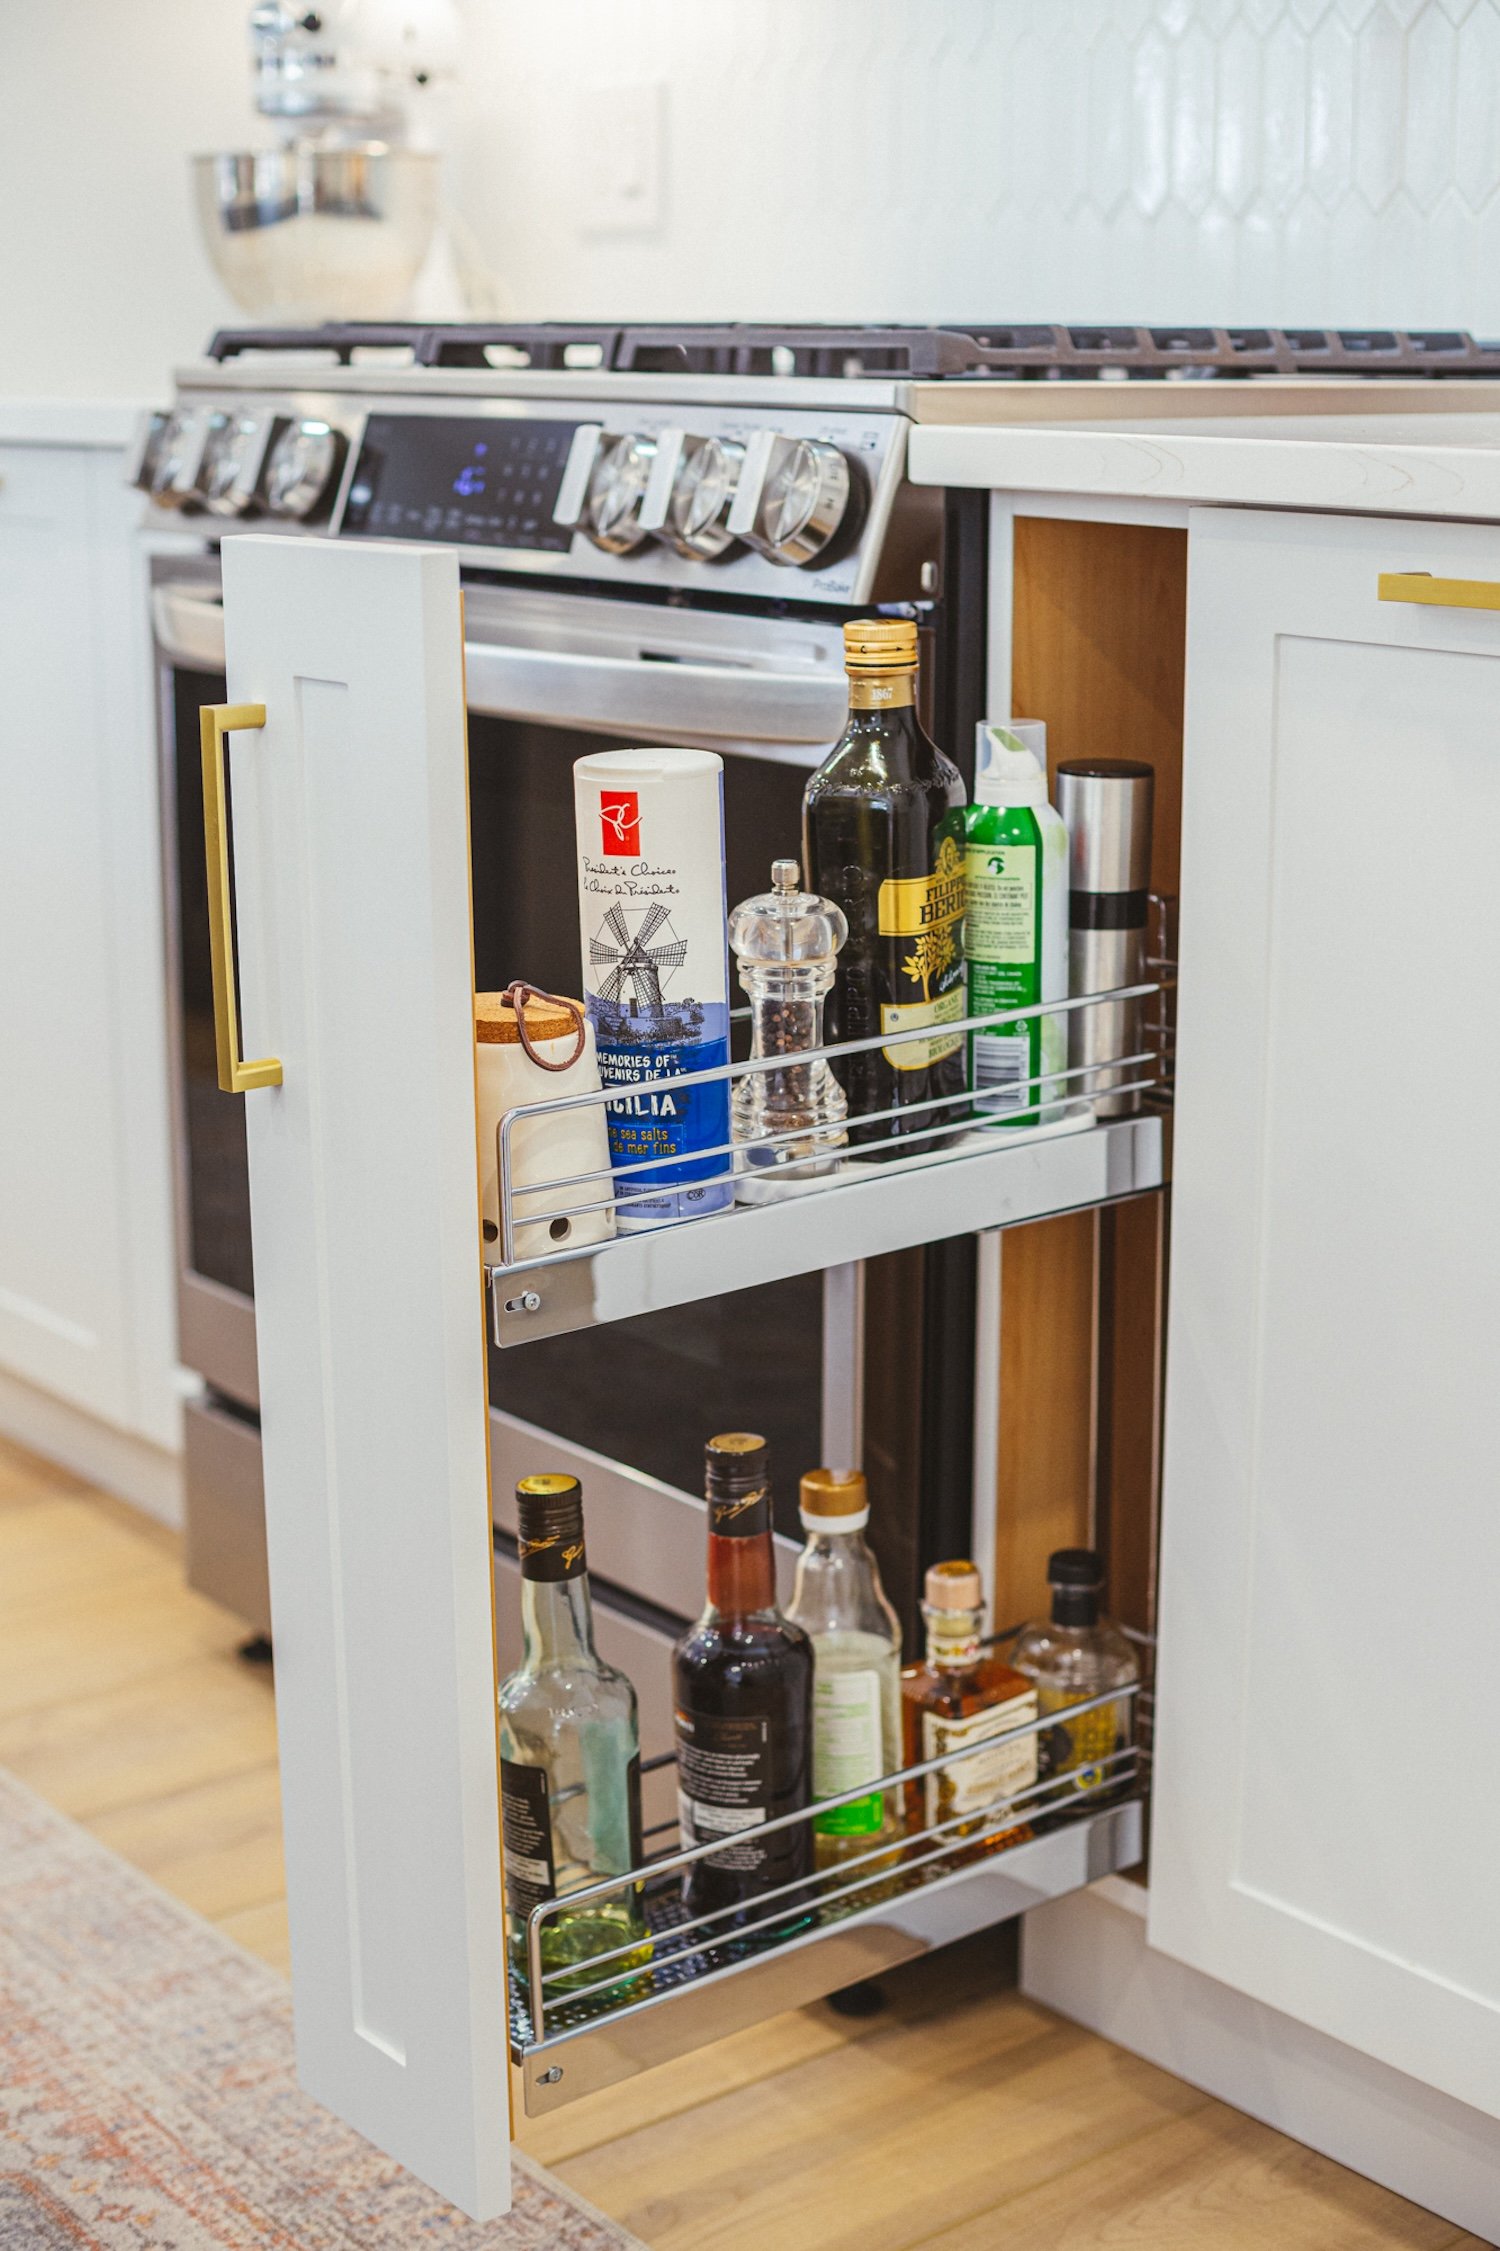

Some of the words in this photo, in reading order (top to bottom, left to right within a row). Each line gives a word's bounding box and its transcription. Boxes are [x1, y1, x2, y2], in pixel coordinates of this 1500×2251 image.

[606, 1094, 677, 1116] ICILIA
[620, 1129, 637, 1140] sea
[640, 1127, 668, 1141] salts
[627, 1143, 649, 1154] mer
[653, 1141, 676, 1154] fins
